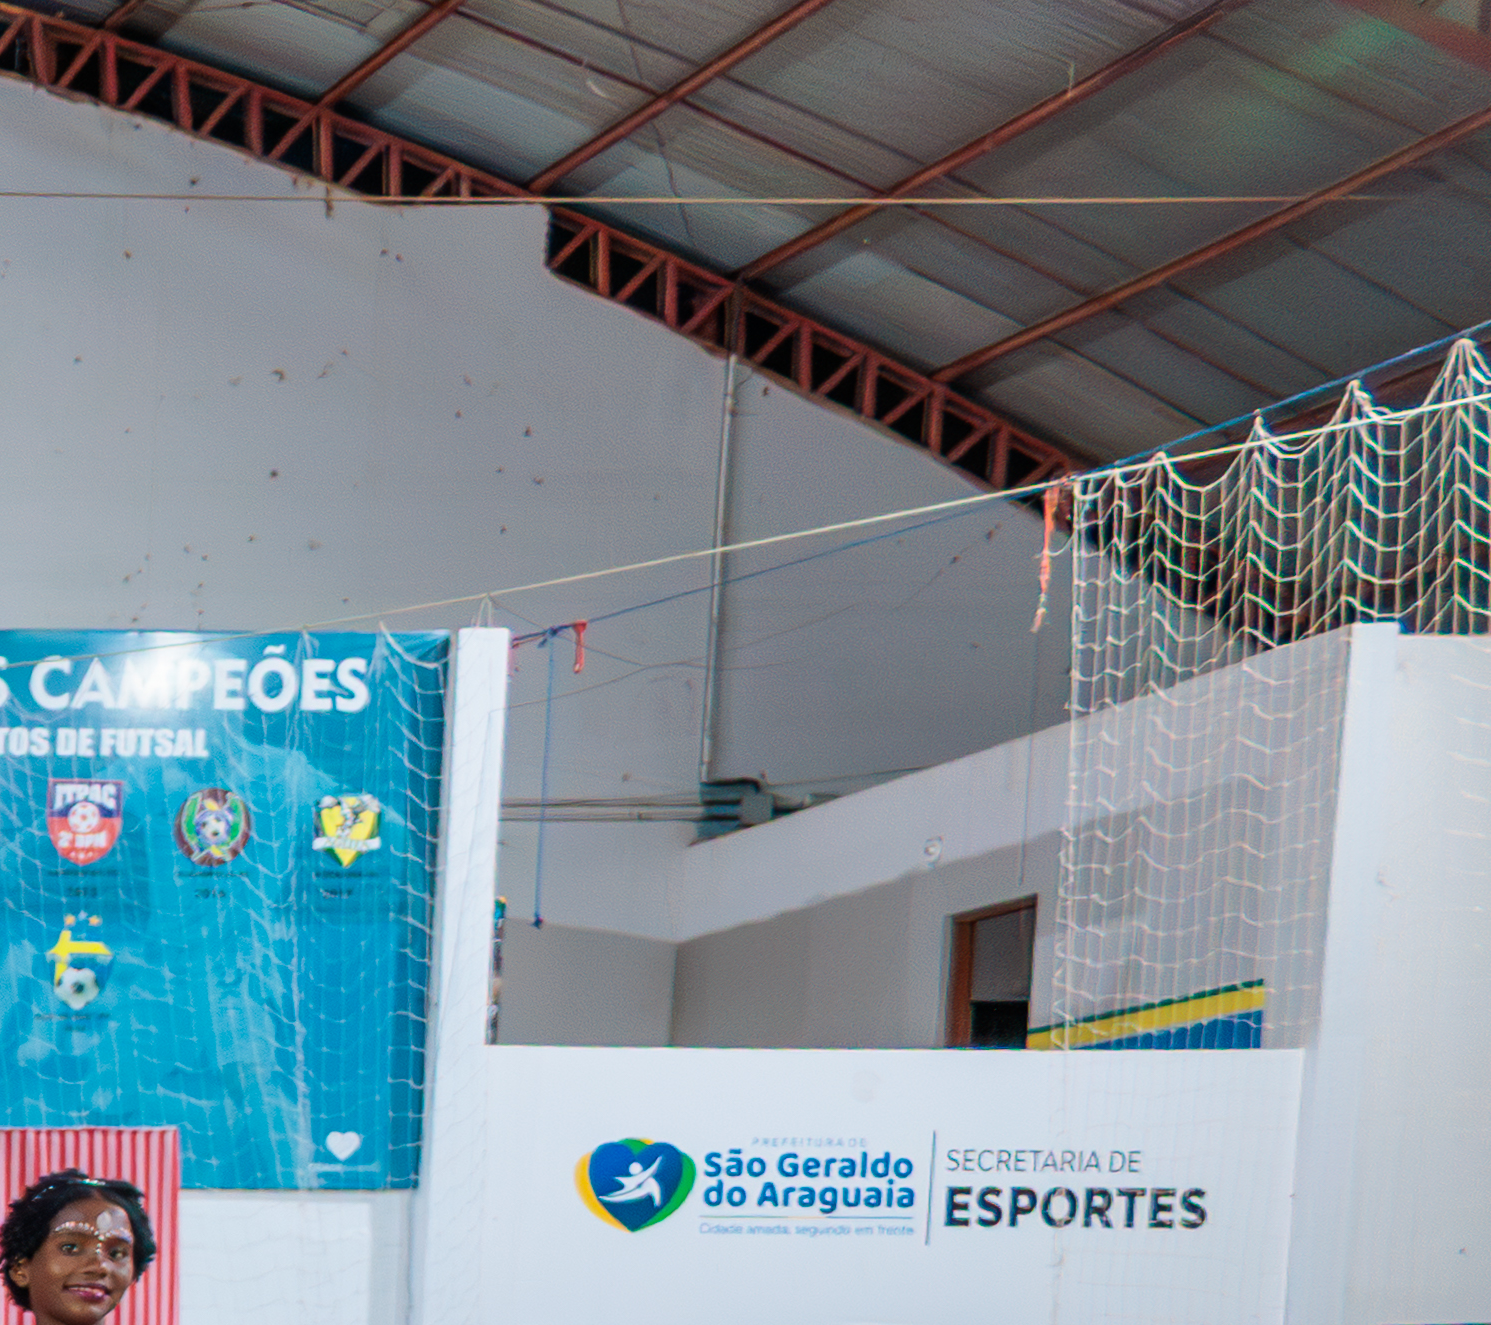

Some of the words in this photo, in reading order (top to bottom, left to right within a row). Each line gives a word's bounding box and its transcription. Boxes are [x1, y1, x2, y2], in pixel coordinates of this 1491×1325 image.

[29, 644, 370, 714] CAMPEÕES
[56, 727, 94, 757] DE
[99, 727, 209, 758] FUTSAL
[703, 1148, 767, 1178] São
[776, 1151, 914, 1178] Geraldo
[945, 1149, 1101, 1172] SECRETARIA
[1108, 1150, 1142, 1173] DE
[703, 1179, 747, 1207] do
[756, 1179, 915, 1213] Araguaia
[943, 1186, 1208, 1229] ESPORTES
